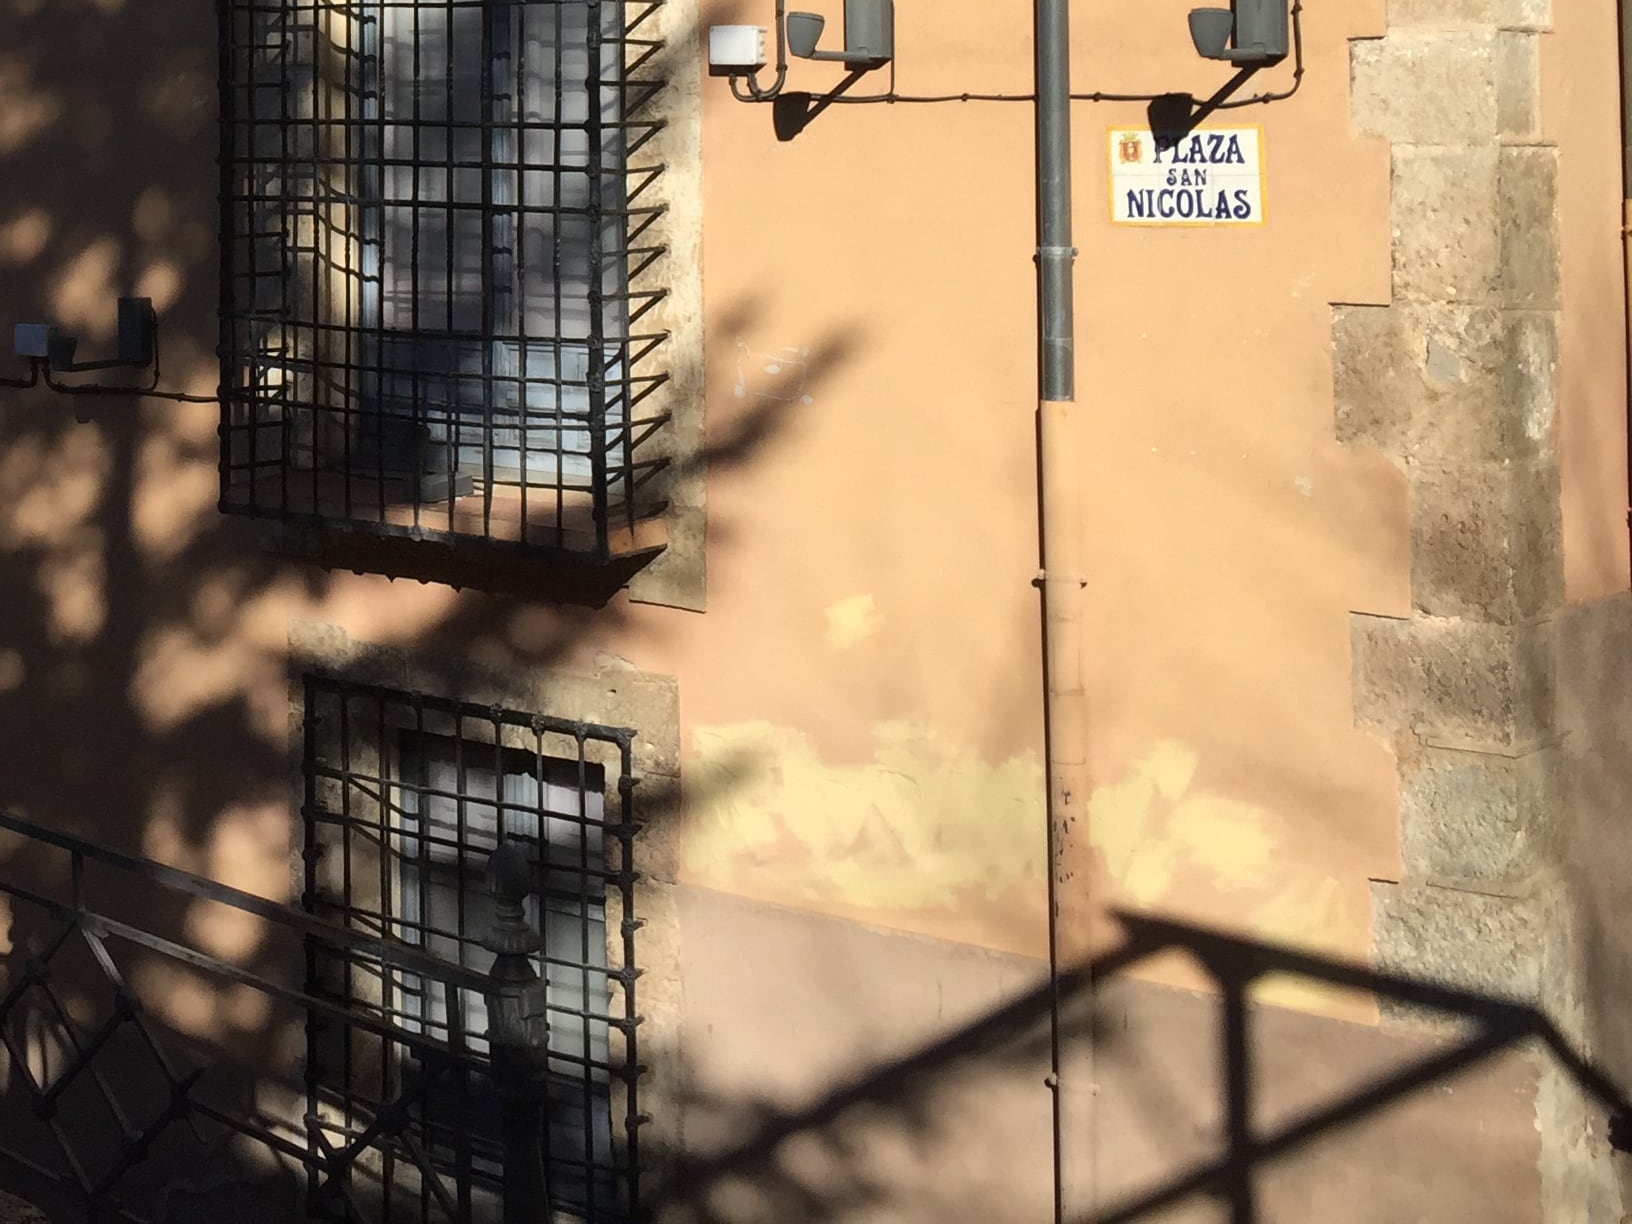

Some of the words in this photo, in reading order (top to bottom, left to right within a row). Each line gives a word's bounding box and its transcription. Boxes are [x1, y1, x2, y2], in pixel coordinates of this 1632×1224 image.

[1153, 134, 1245, 164] PLAZA
[1166, 168, 1207, 186] SAN
[1126, 188, 1251, 219] NICOLAS
